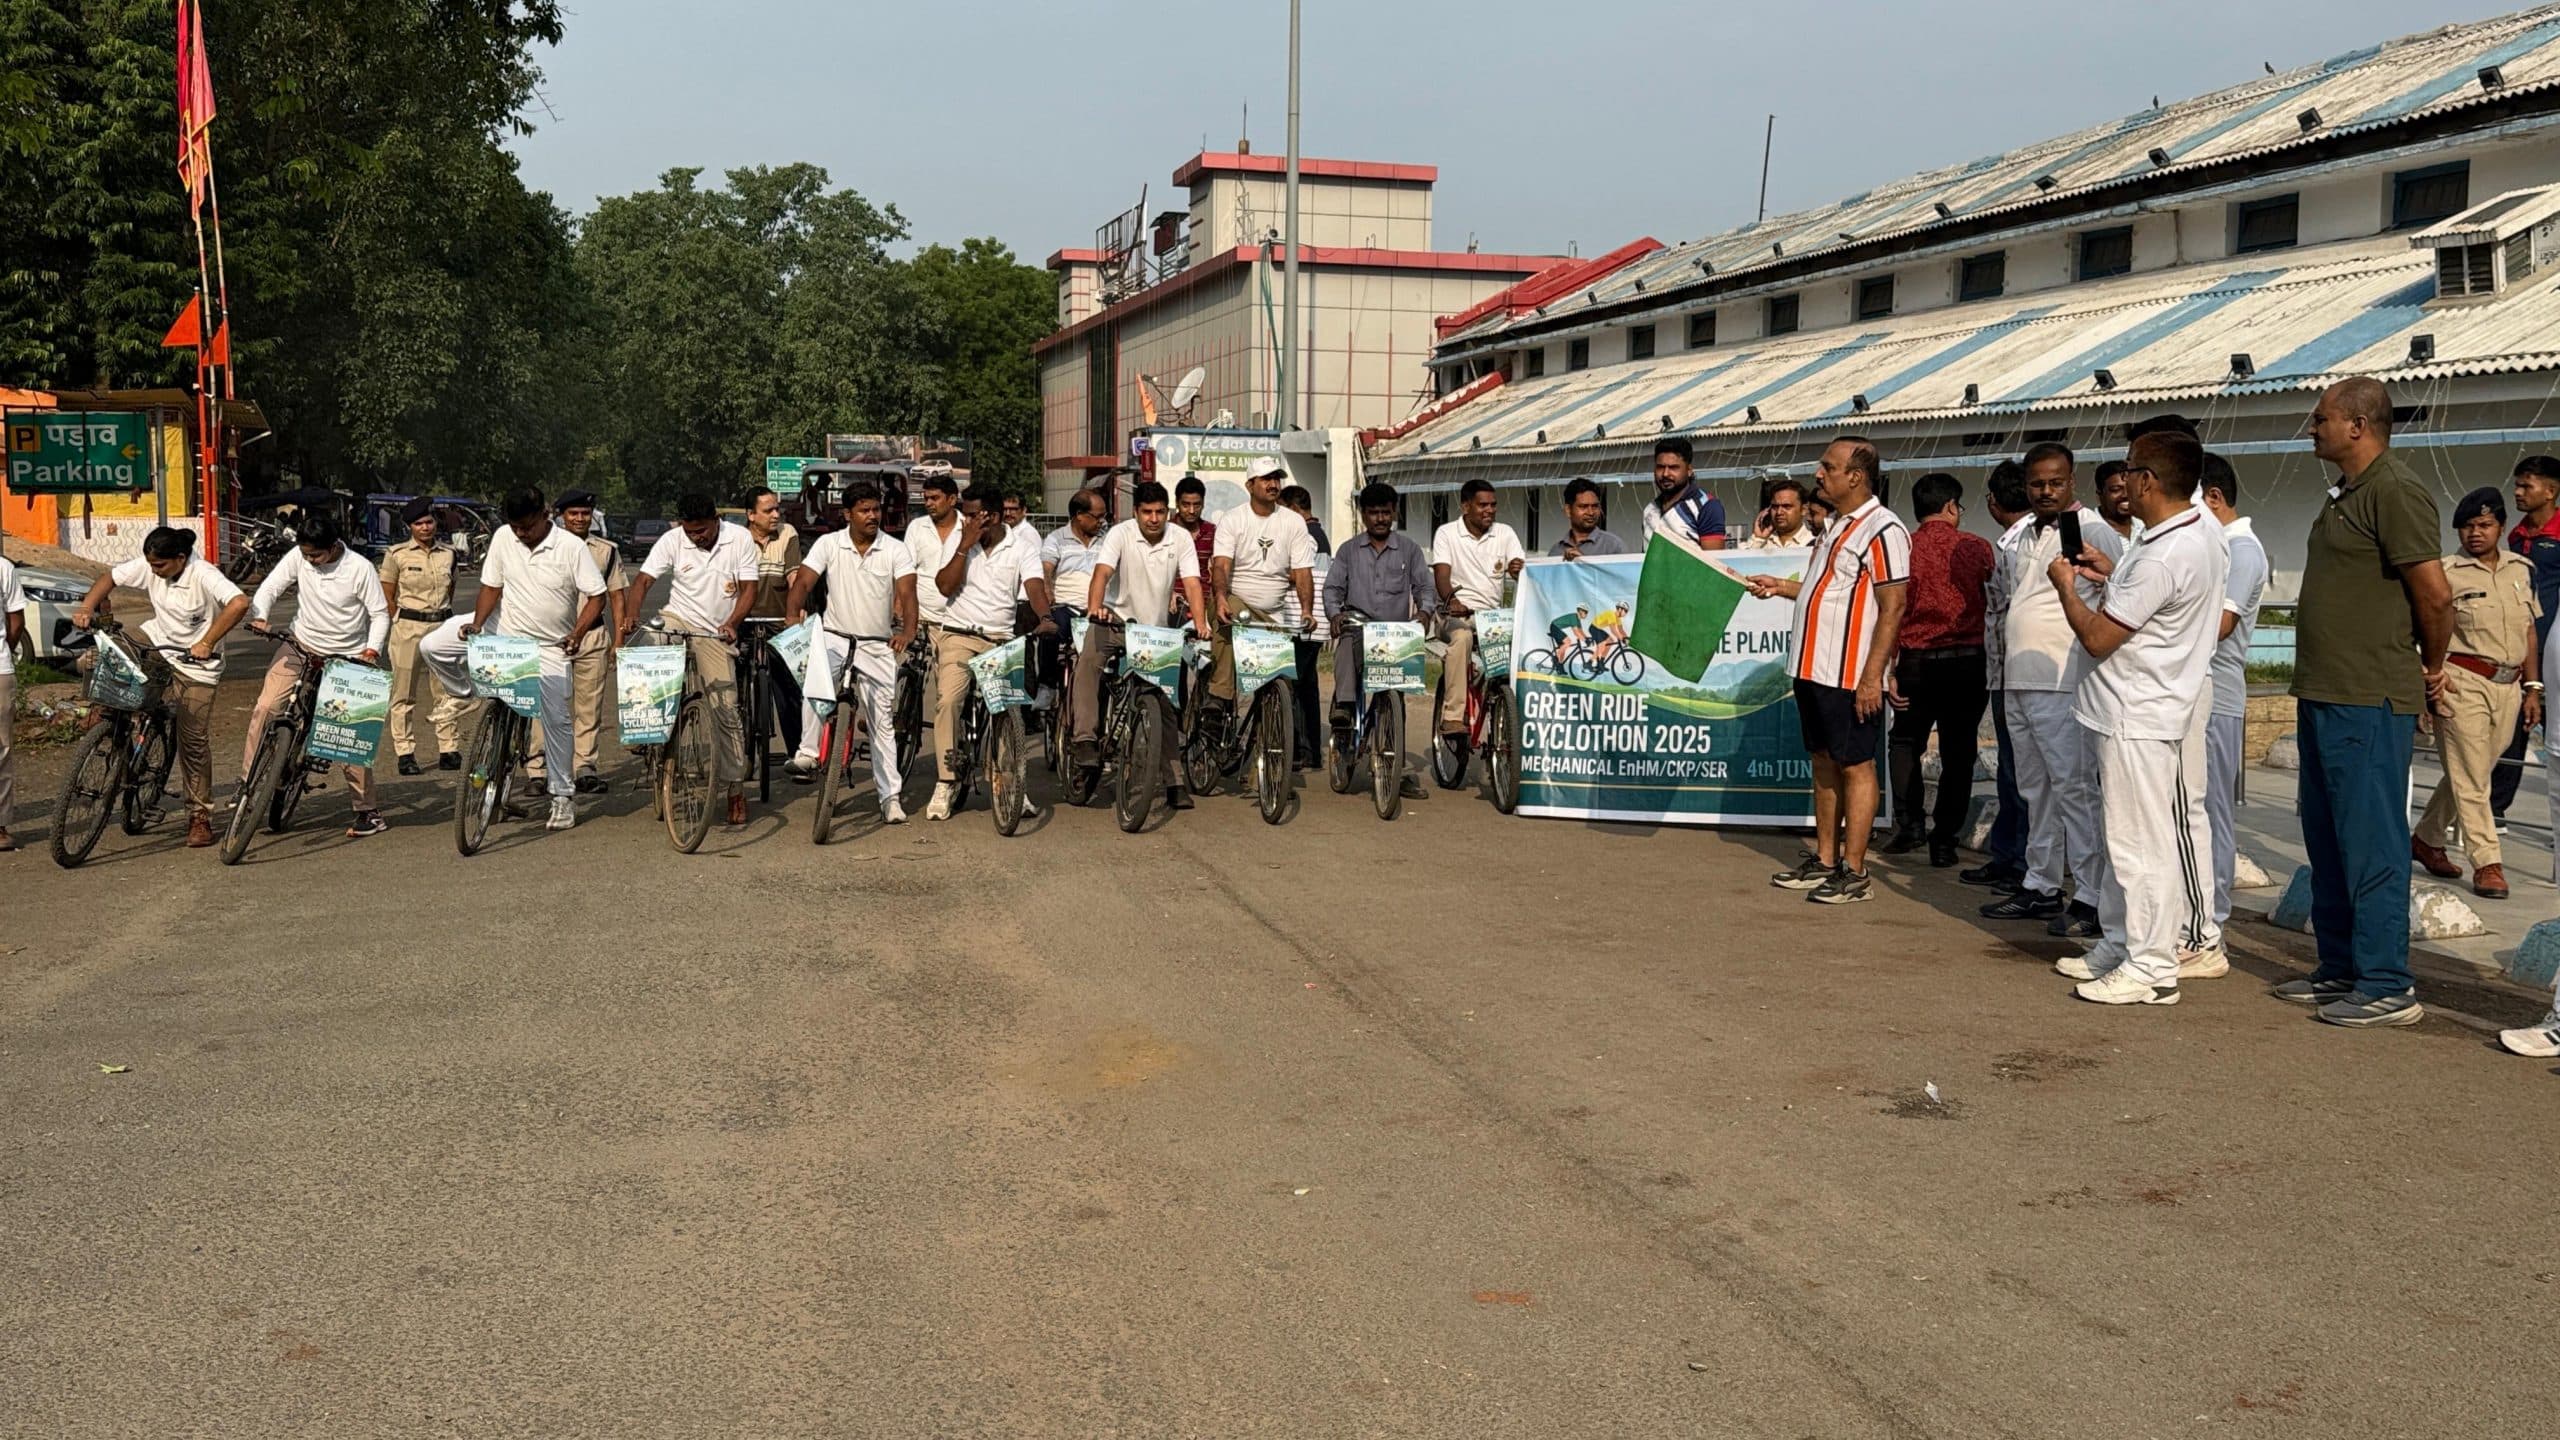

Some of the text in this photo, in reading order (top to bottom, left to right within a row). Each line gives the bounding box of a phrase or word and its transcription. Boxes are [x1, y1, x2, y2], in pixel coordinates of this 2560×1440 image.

[45, 424, 119, 453] पड़ाव
[12, 460, 133, 487] Parking
[1191, 454, 1226, 469] STATE
[1229, 456, 1257, 468] BAN
[1524, 691, 1649, 722] GREEN RIDE
[354, 739, 373, 751] 2025
[1522, 721, 1711, 754] CYCLOTHON 2025
[1521, 755, 1728, 779] MECHANICAL EnHM/CKP/SER
[1746, 759, 1813, 782] 4th JUN
